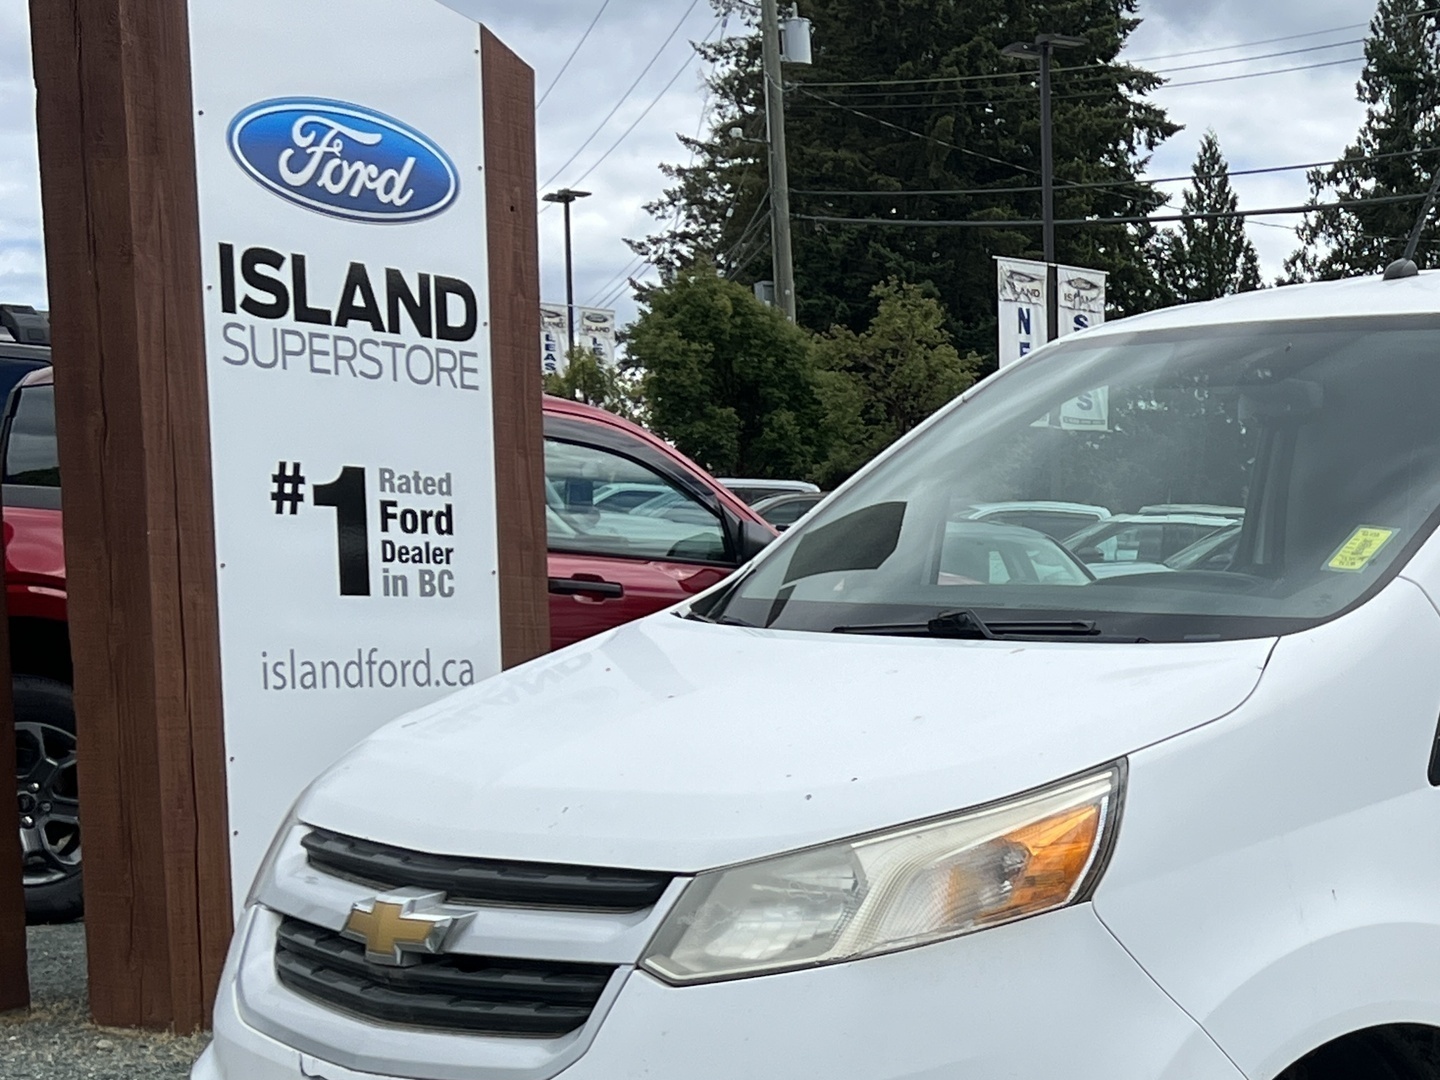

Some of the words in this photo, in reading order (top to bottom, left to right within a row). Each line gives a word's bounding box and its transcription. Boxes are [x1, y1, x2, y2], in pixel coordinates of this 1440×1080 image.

[278, 115, 416, 206] Ford
[218, 241, 478, 342] ISLAND
[222, 321, 480, 391] SUPERSTORE
[378, 467, 452, 497] Rated
[270, 461, 371, 597] #1
[379, 499, 454, 536] Ford
[381, 539, 454, 565] Dealer
[382, 567, 408, 597] in
[418, 569, 455, 598] BC
[261, 647, 475, 691] islandford.ca
